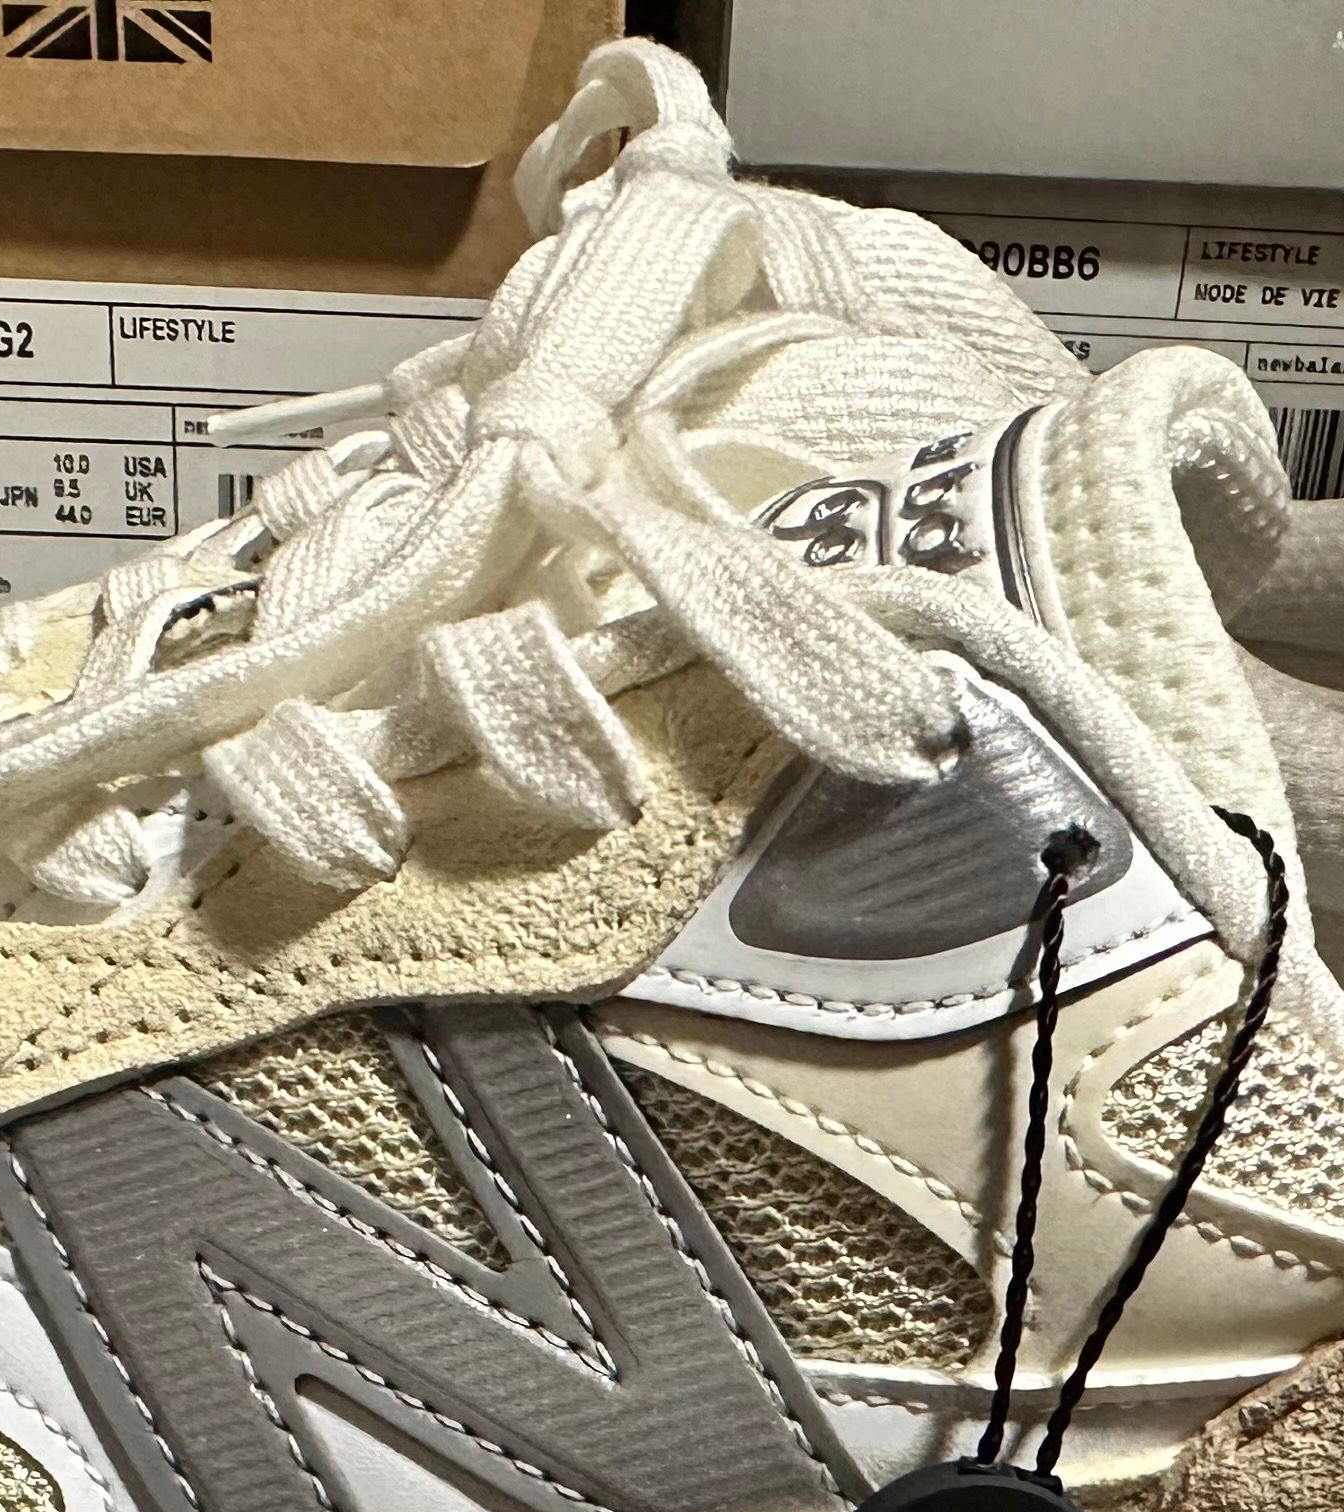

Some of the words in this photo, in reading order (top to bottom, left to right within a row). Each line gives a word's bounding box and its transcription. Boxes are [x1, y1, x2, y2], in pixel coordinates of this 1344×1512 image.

[958, 239, 1102, 282] 90BB6
[1201, 240, 1321, 265] LIFESTYLE
[1261, 286, 1290, 306] DE
[1301, 288, 1341, 308] VIE
[119, 315, 237, 344] LIFESTYLE
[124, 456, 168, 478] USA
[0, 486, 40, 508] JPN
[125, 480, 154, 503] UK
[126, 506, 168, 528] EUR
